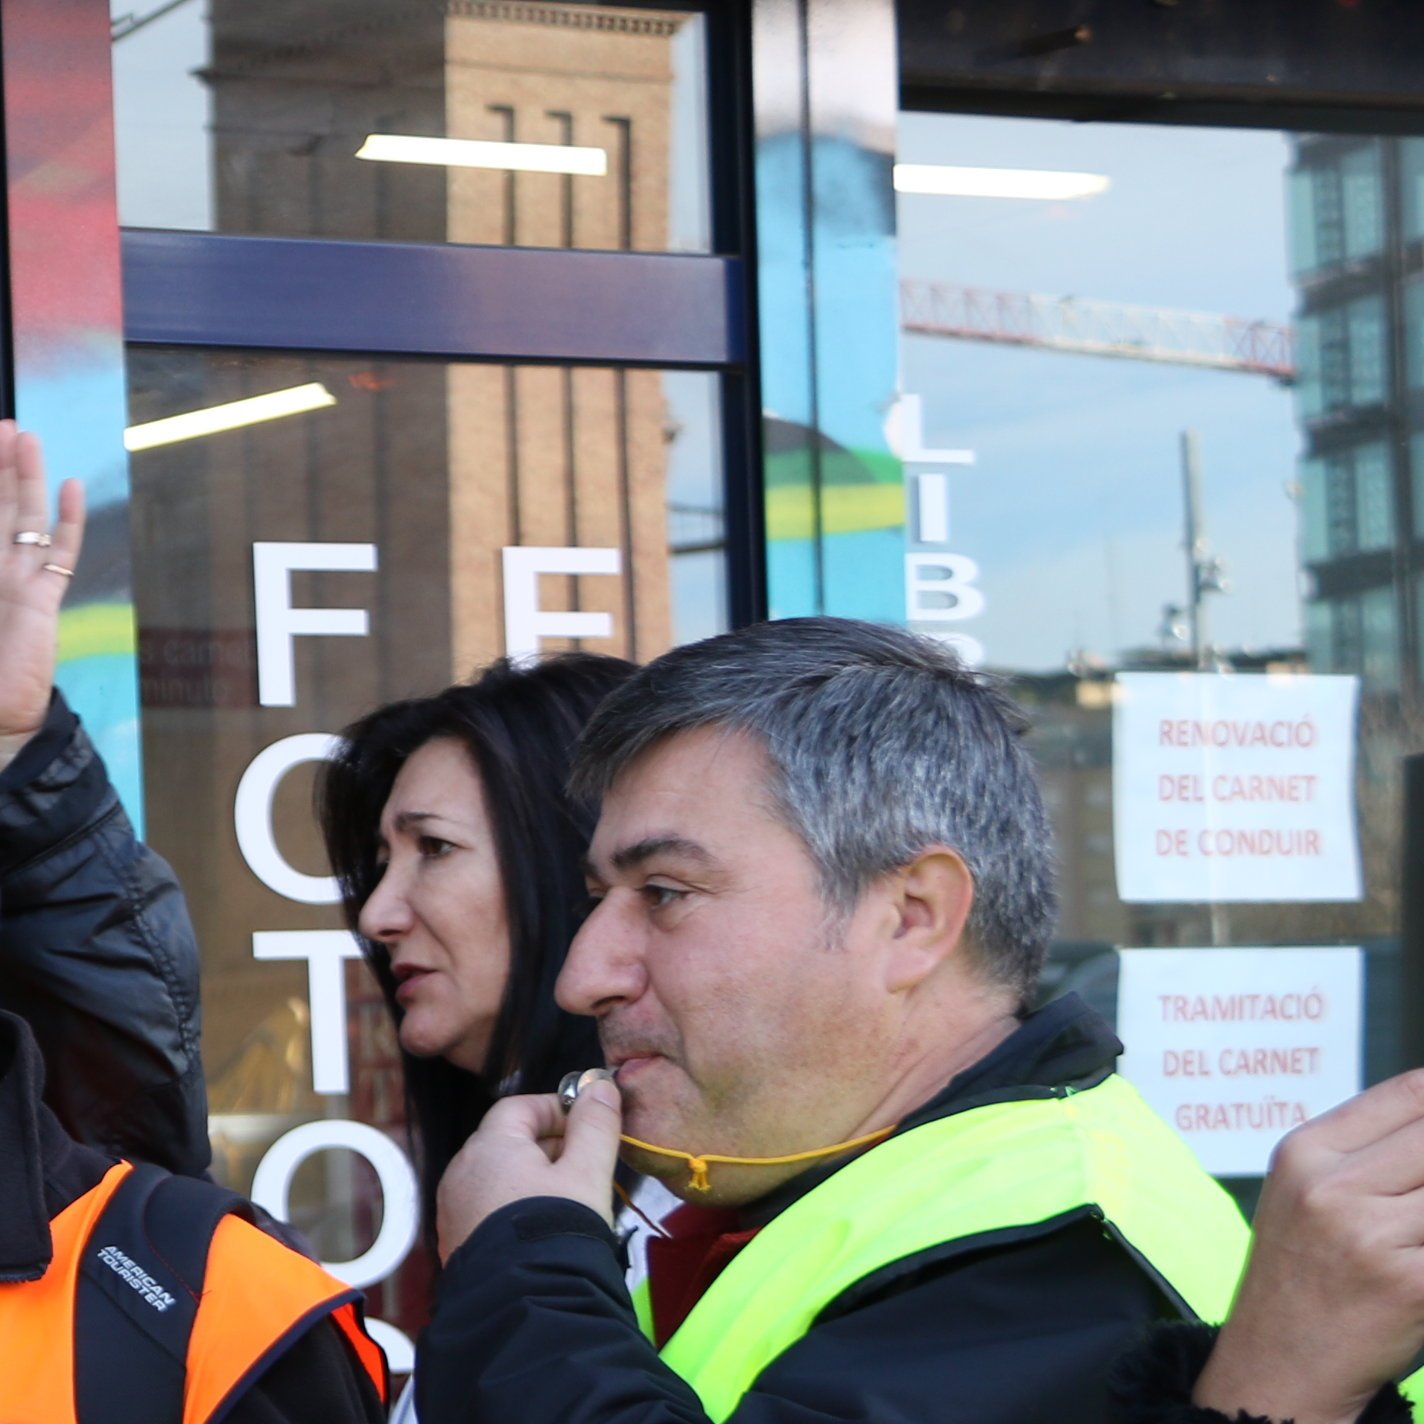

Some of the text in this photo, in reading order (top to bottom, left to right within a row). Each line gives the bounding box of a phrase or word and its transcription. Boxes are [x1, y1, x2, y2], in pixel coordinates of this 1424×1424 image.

[1158, 714, 1316, 747] RENOVACIÓ
[1158, 774, 1317, 802] DEL CARNET
[1155, 828, 1321, 856] DE CONDUIR
[1158, 986, 1325, 1021] TRAMITACIÓ
[1162, 1047, 1320, 1077] DEL CARNET
[1174, 1096, 1307, 1131] GRATUÏTA
[97, 1249, 168, 1312] TOURISTER
[104, 1246, 176, 1306] AMERICAN
